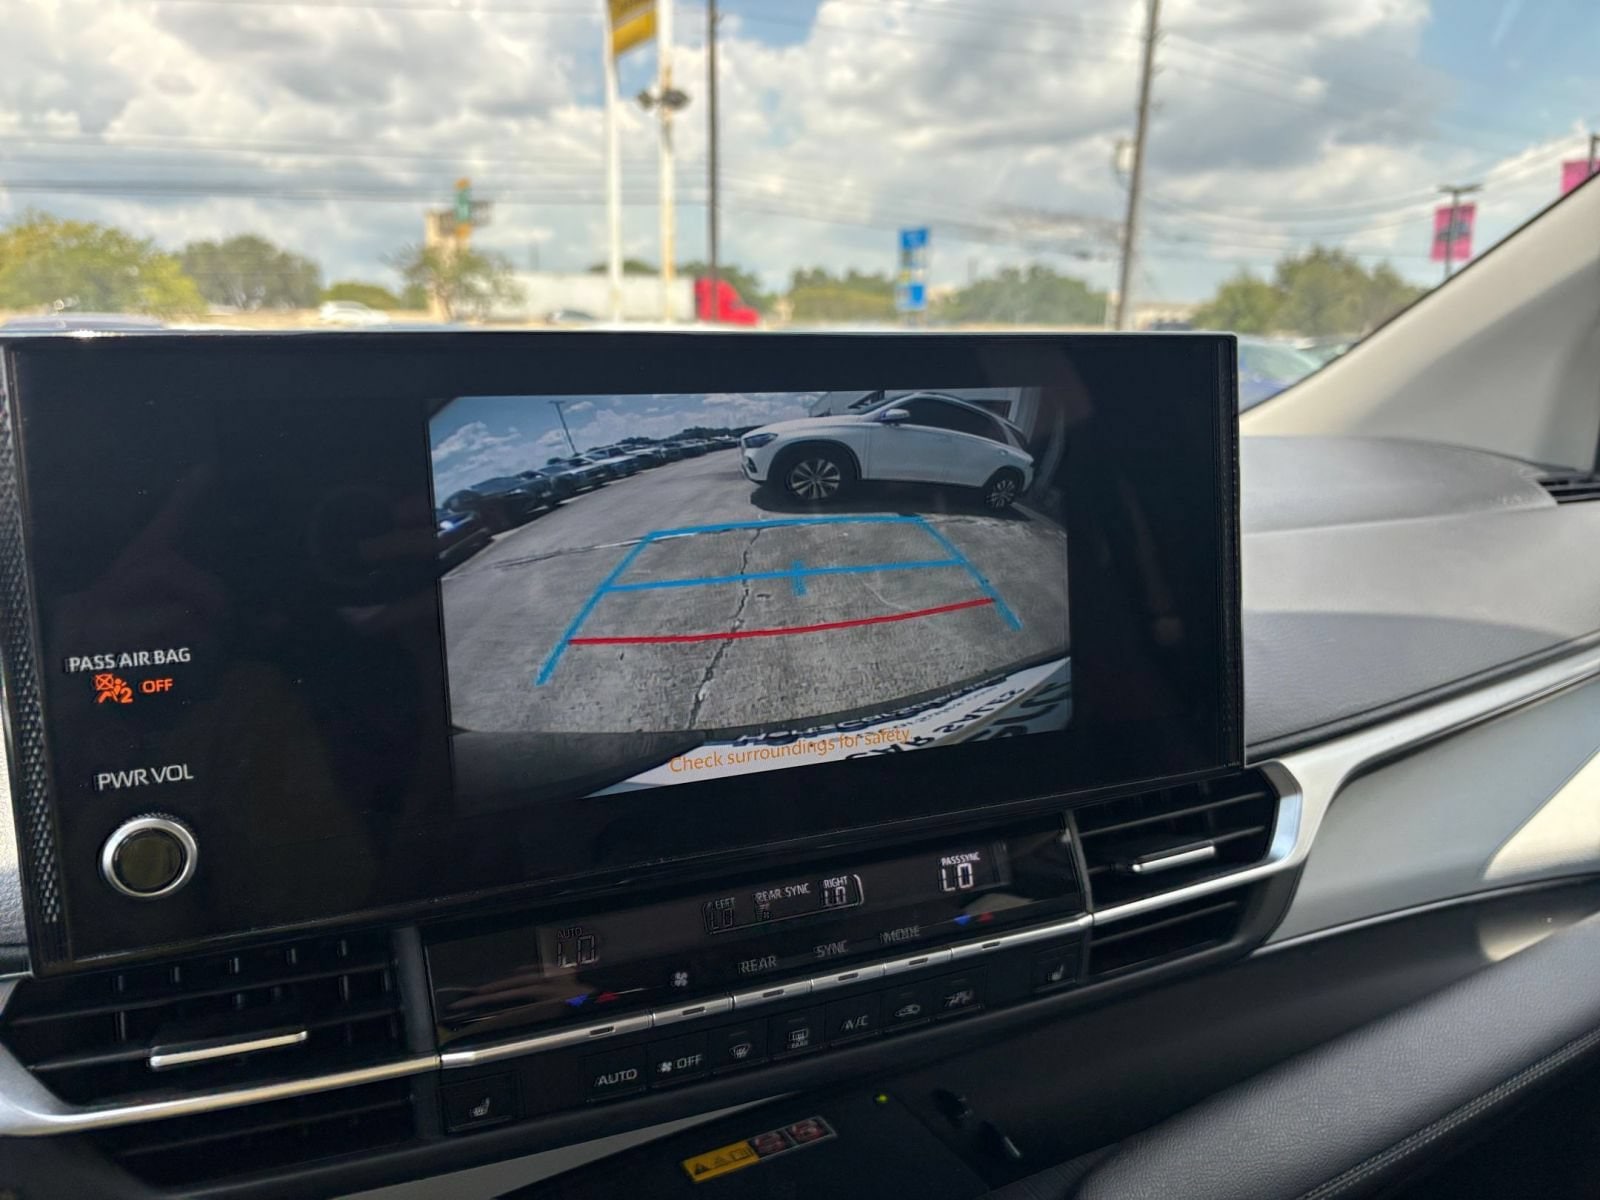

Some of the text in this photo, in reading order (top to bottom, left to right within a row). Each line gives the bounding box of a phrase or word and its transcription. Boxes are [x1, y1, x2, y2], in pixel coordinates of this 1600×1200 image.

[68, 647, 191, 673] PASS AIR BAG
[142, 678, 174, 693] OFF
[669, 749, 723, 773] Check
[727, 734, 835, 766] surroundings
[838, 733, 861, 749] for
[97, 763, 194, 791] PWR VOL
[784, 883, 811, 897] SYNC
[823, 876, 848, 888] RIGHT
[813, 939, 849, 958] SYNC
[738, 955, 777, 974] REAR
[675, 1054, 702, 1070] OFF
[596, 1068, 638, 1086] AUTO
